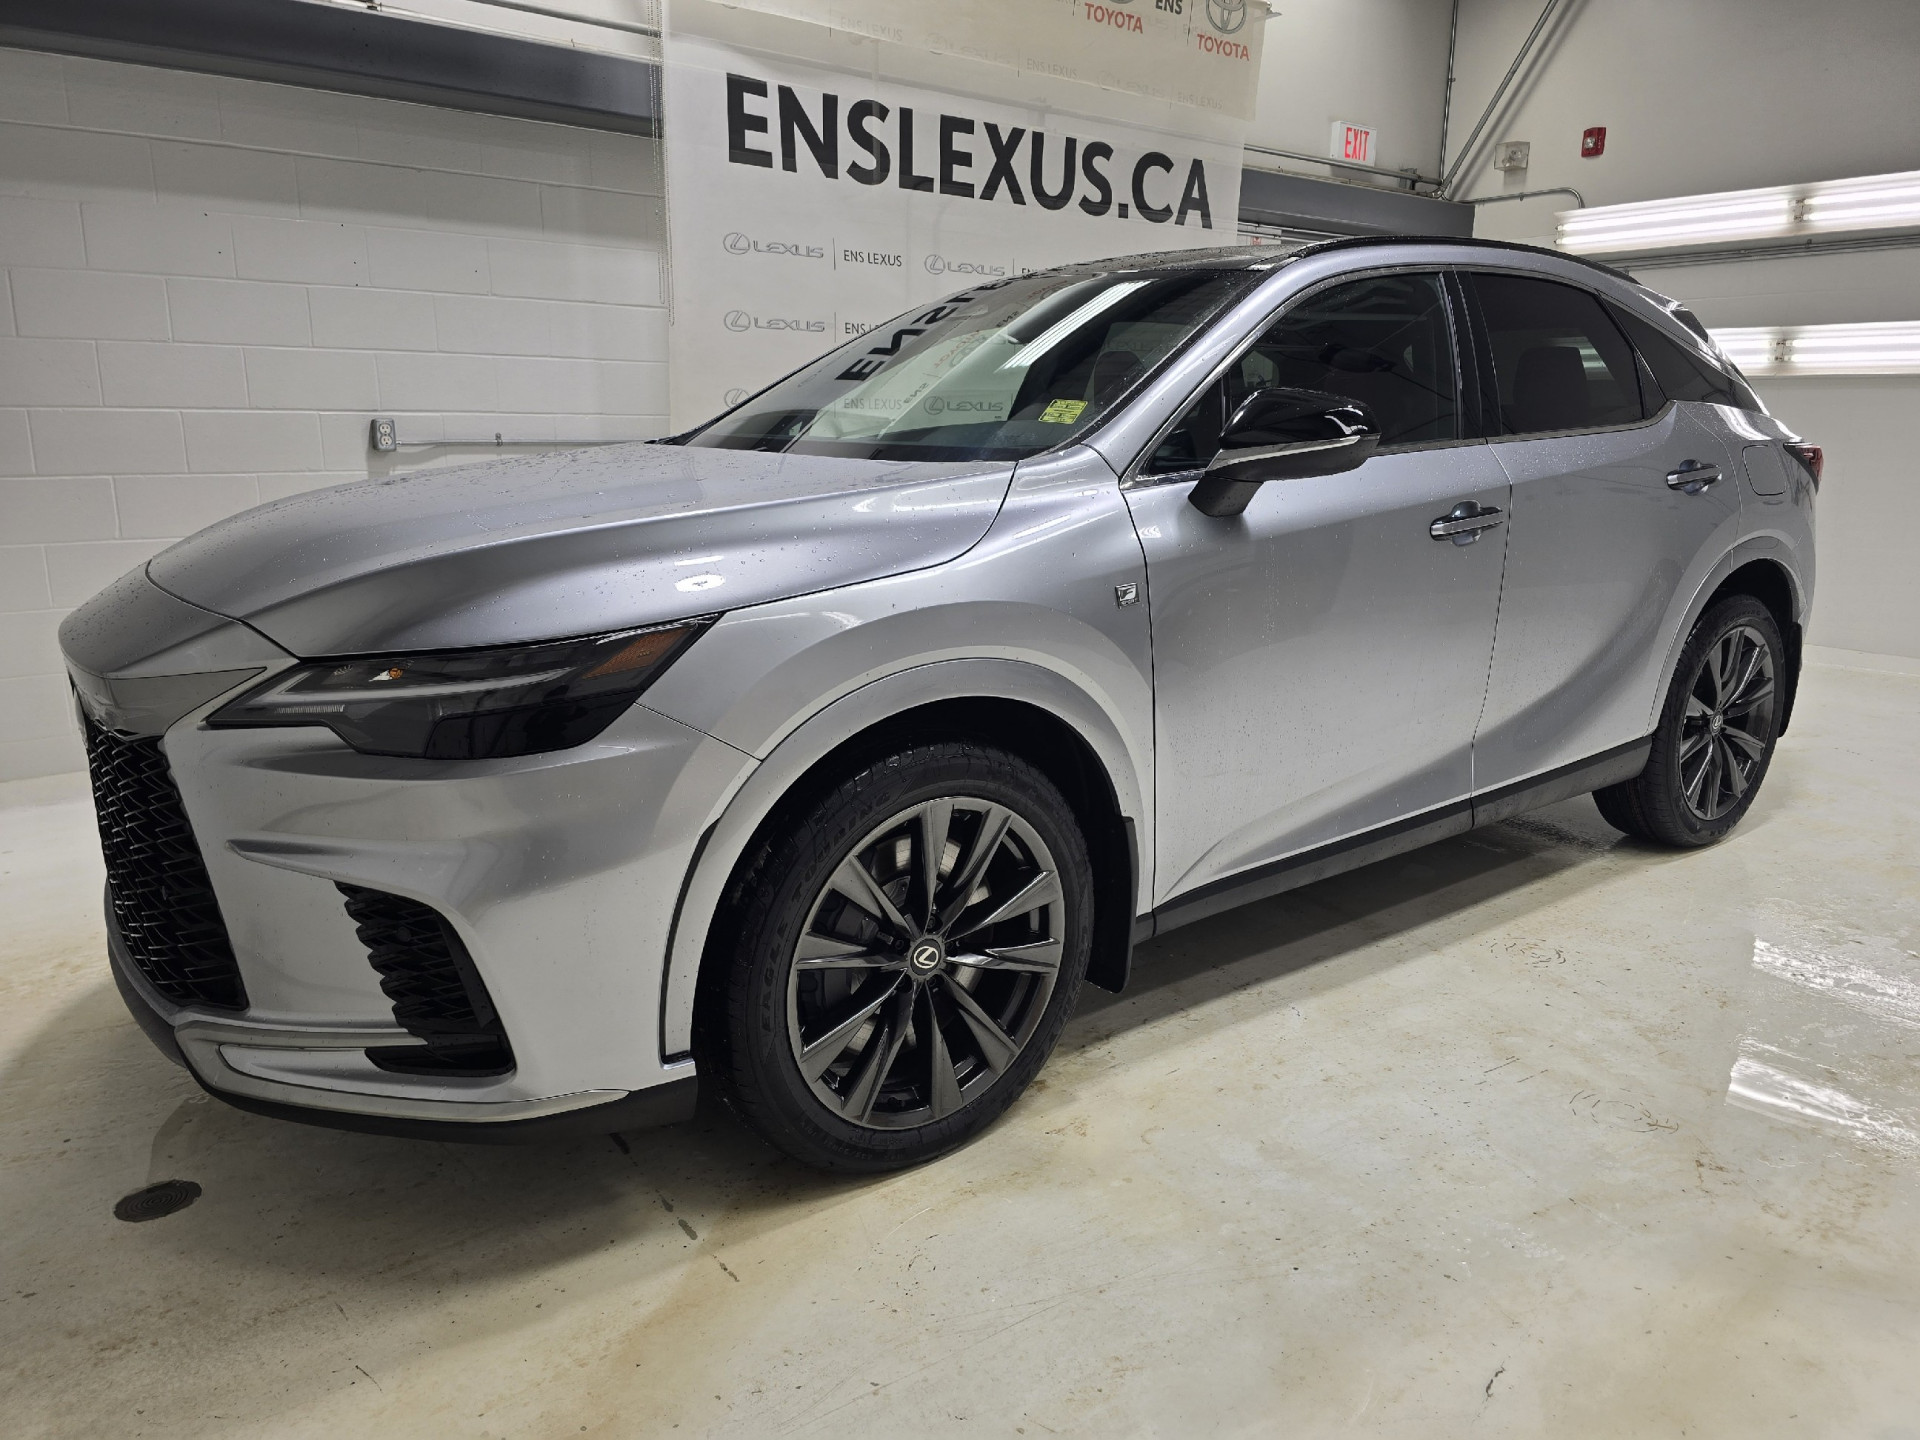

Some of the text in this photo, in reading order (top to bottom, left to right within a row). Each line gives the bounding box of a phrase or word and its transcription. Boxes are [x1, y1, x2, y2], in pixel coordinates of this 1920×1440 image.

[1085, 3, 1143, 34] TOYOTA
[1155, 0, 1183, 15] ENS
[1197, 33, 1250, 61] TOYOTA
[726, 72, 1213, 230] ENSLEXUS.CA
[1344, 126, 1370, 162] EXIT
[753, 239, 902, 267] LEXUS ENS LEXUS
[947, 260, 1005, 276] LEXUS
[753, 316, 825, 332] LEXUS
[844, 322, 866, 335] ENS
[844, 399, 1003, 412] ENS LEXUS LEXUS
[760, 921, 789, 1033] EAGLE
